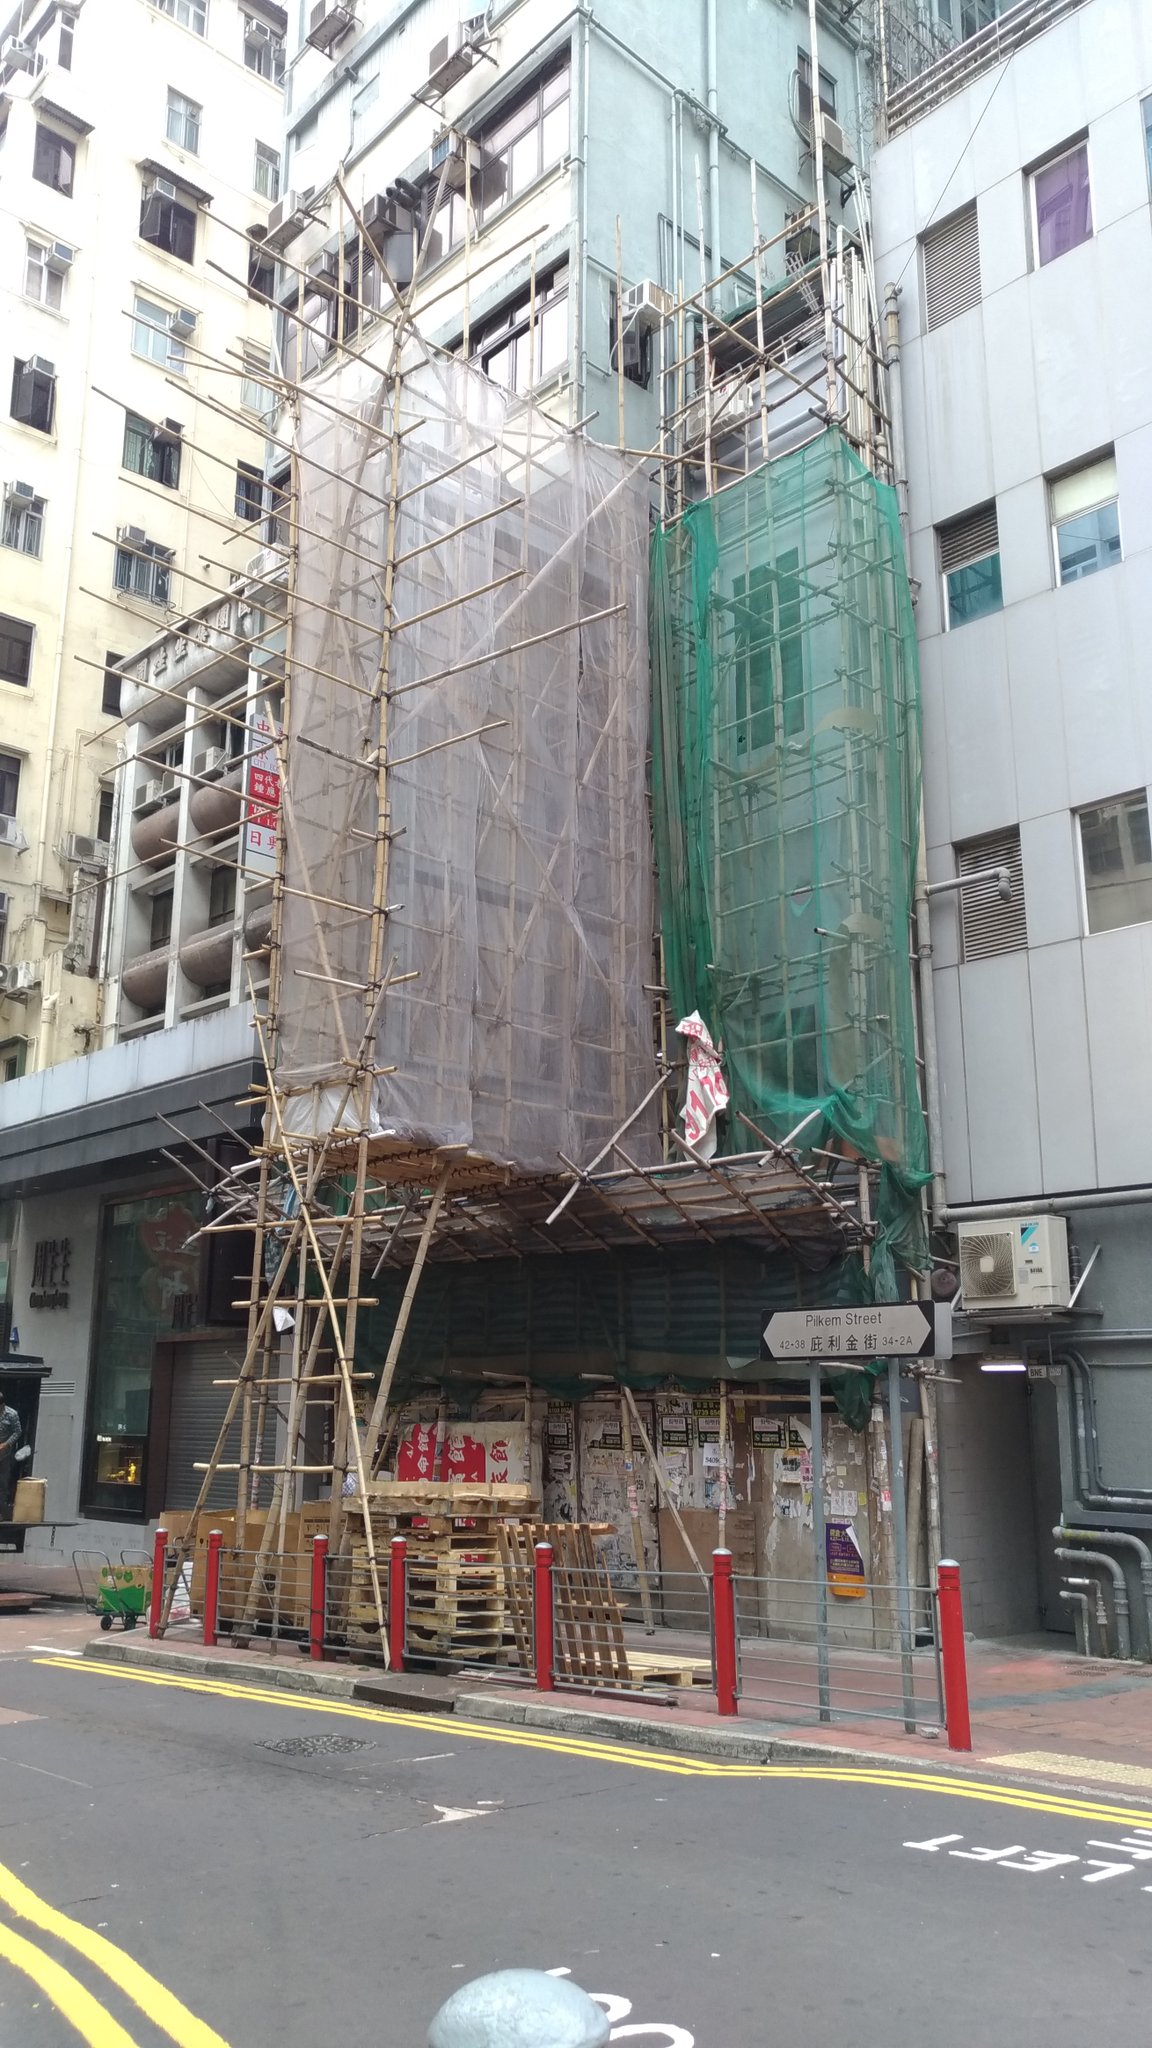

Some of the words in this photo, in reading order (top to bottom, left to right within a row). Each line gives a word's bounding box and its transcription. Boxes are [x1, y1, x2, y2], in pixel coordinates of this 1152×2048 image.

[806, 1314, 841, 1327] Pilkem
[845, 1311, 882, 1325] Street
[810, 1334, 878, 1352] 庇利金街
[902, 1833, 1136, 1883] LEFT
